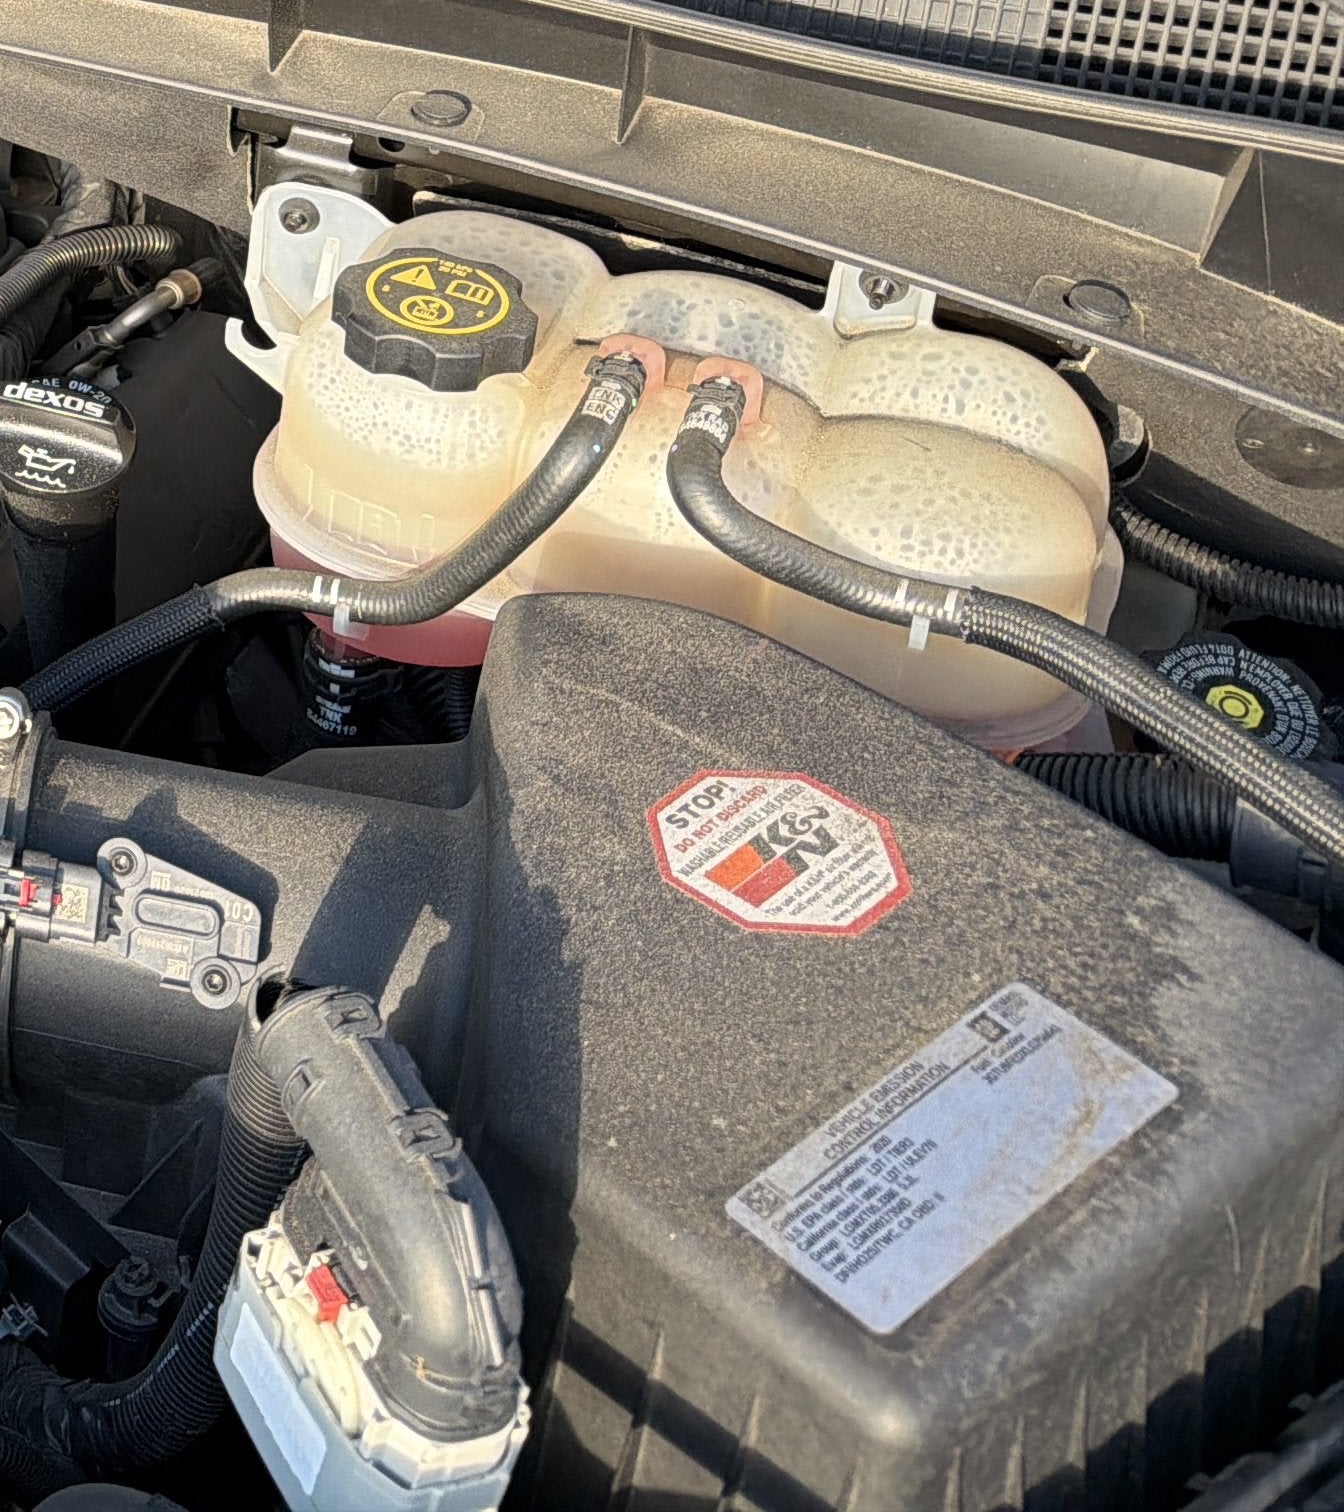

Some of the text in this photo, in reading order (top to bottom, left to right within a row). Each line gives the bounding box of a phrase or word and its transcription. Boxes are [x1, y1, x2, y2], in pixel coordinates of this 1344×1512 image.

[3, 382, 105, 418] dexos
[585, 400, 617, 421] ENG
[710, 413, 728, 432] RAD
[1216, 656, 1235, 667] CAP
[662, 778, 737, 831] STOP!
[672, 783, 770, 853] DO NOT DISCARD
[820, 1059, 926, 1138] VEHICLE EMISSION
[821, 1060, 951, 1160] CONTROL INFORMATION
